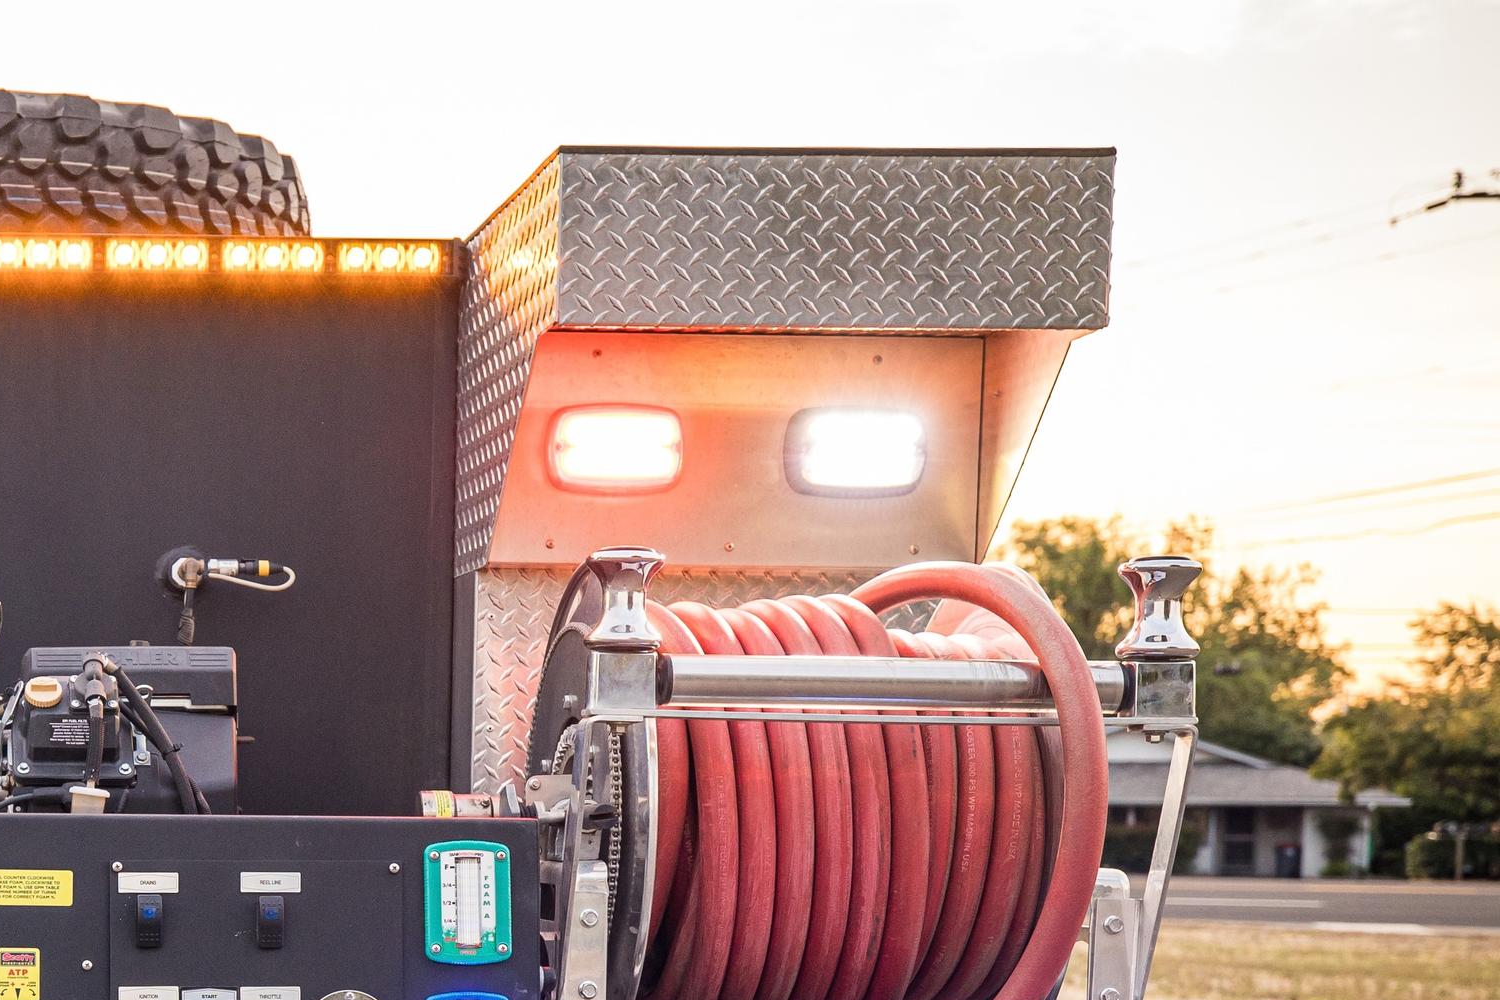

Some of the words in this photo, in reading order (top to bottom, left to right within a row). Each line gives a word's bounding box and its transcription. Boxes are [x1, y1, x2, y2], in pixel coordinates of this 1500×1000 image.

[966, 725, 976, 760] OOSTER
[968, 796, 976, 811] WP
[961, 854, 970, 873] USA
